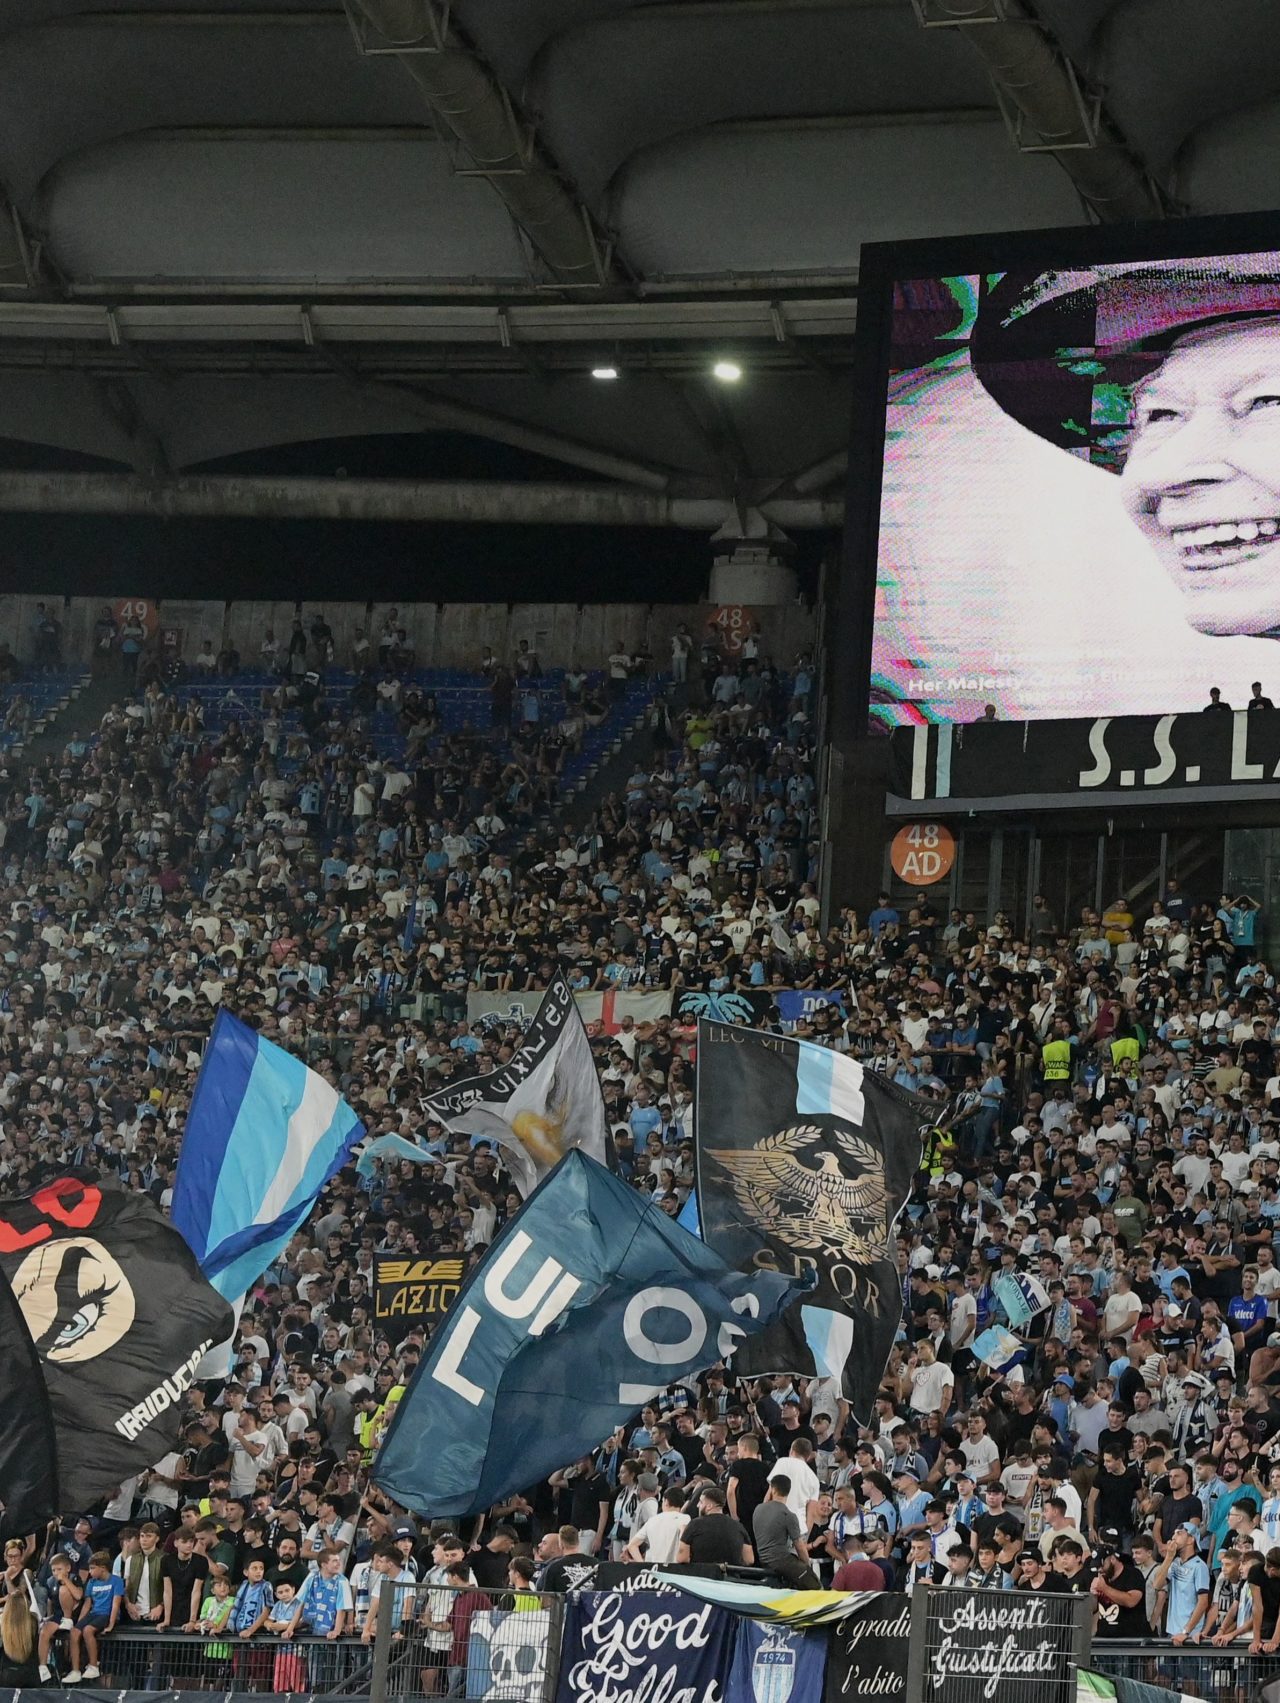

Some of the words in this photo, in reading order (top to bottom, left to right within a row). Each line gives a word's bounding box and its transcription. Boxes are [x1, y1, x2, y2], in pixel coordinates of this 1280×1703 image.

[120, 601, 148, 621] 49
[717, 608, 743, 628] 48
[908, 678, 943, 693] Her
[947, 673, 1023, 692] Majesty
[1079, 714, 1201, 788] S.S.
[905, 823, 940, 849] 48
[900, 851, 941, 876] AD
[938, 1596, 1051, 1634] Assenti
[581, 1592, 713, 1675] Good
[761, 1652, 787, 1664] 1974
[930, 1634, 1058, 1699] Giustificati
[841, 1665, 906, 1695] l'abito
